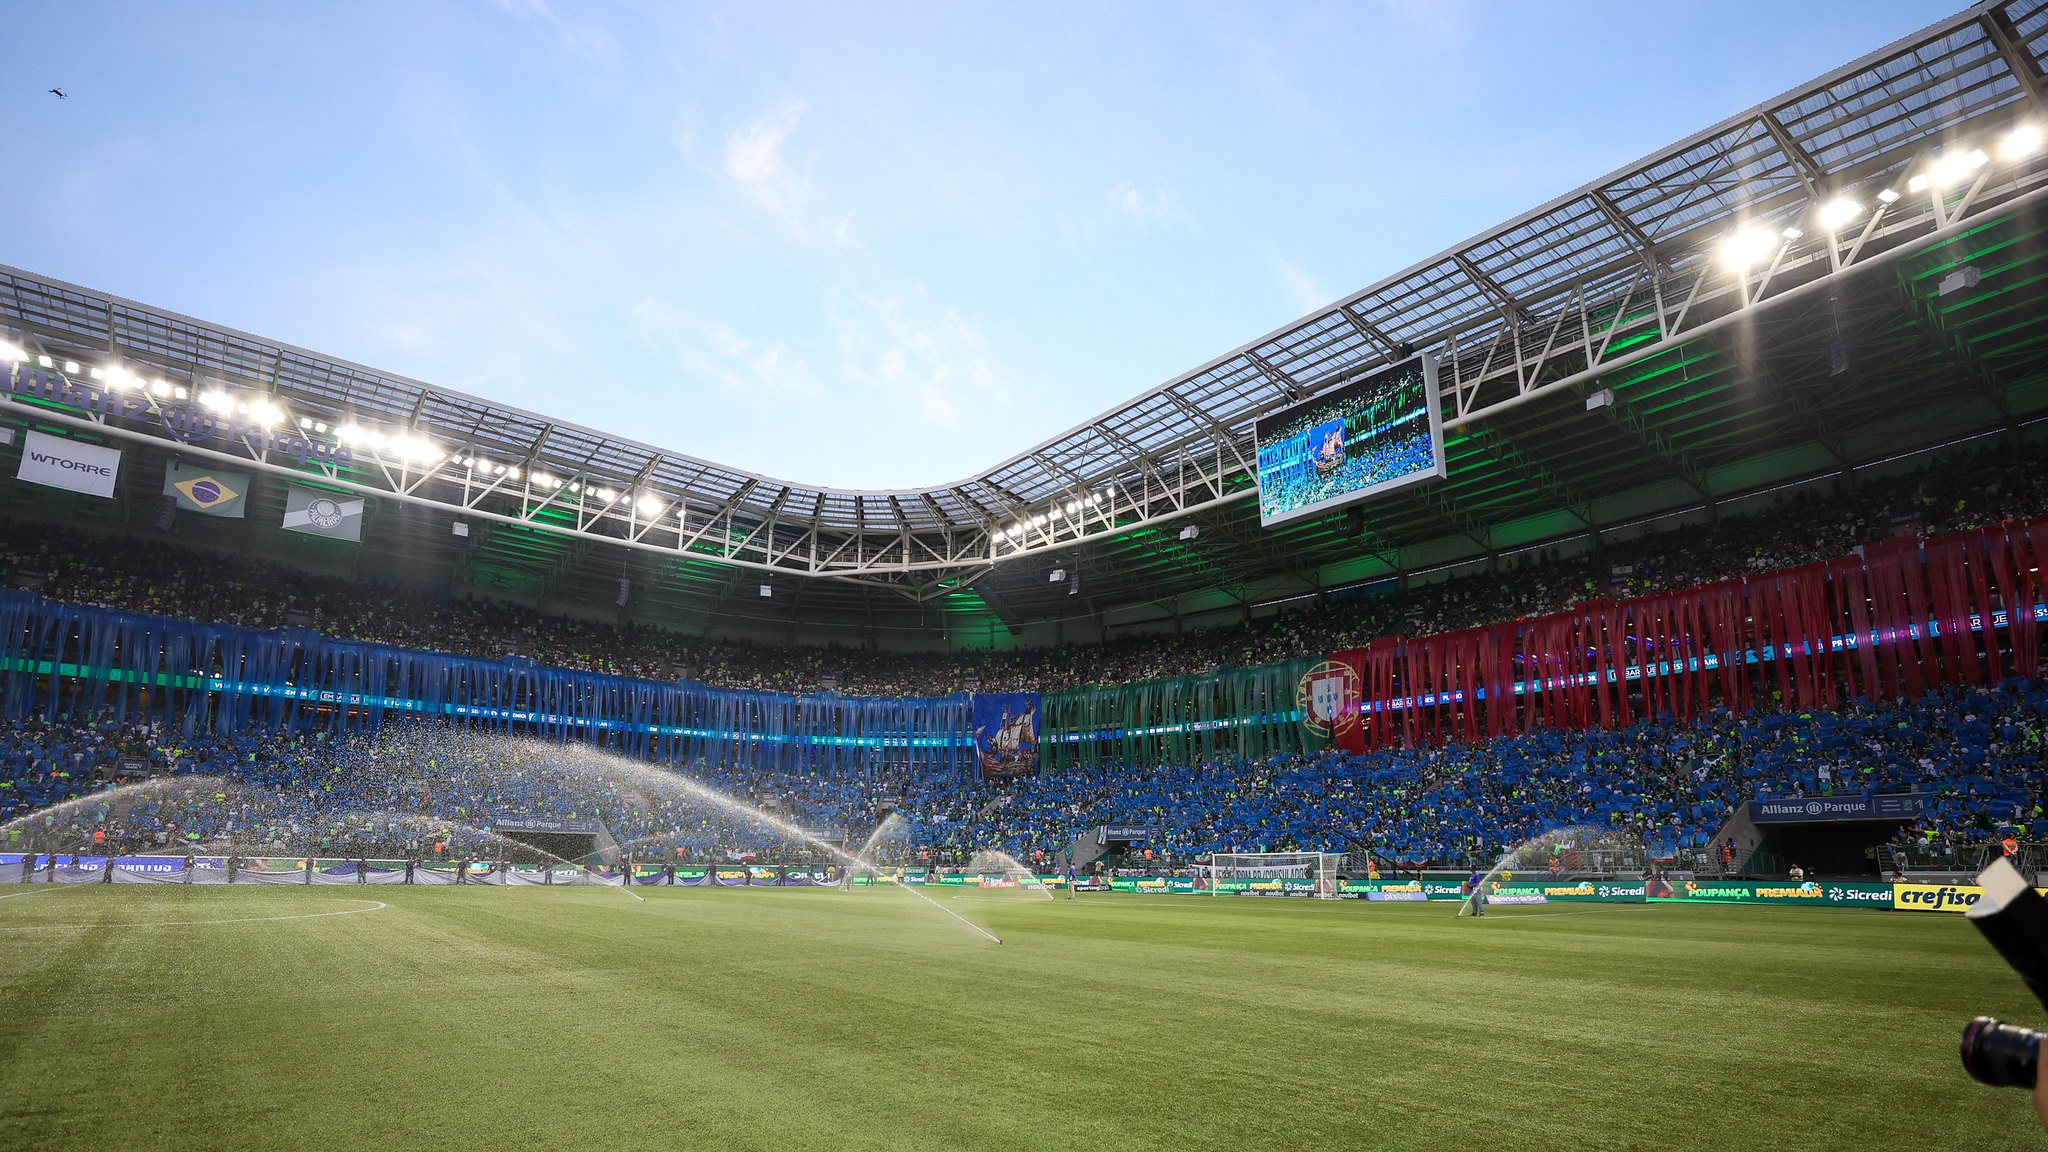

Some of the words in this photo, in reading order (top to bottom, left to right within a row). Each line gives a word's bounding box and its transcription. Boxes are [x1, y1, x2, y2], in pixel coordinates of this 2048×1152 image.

[227, 415, 352, 467] Parque
[31, 452, 111, 476] WTORRE
[1761, 804, 1804, 814] Allianz
[1825, 801, 1867, 814] Parque
[496, 819, 525, 827] Allianz
[537, 820, 562, 829] Parque
[1293, 883, 1315, 891] Sicredi
[1435, 886, 1461, 894] Sicredi
[1612, 887, 1644, 896] Sicredi
[1847, 889, 1892, 901] Sicredi
